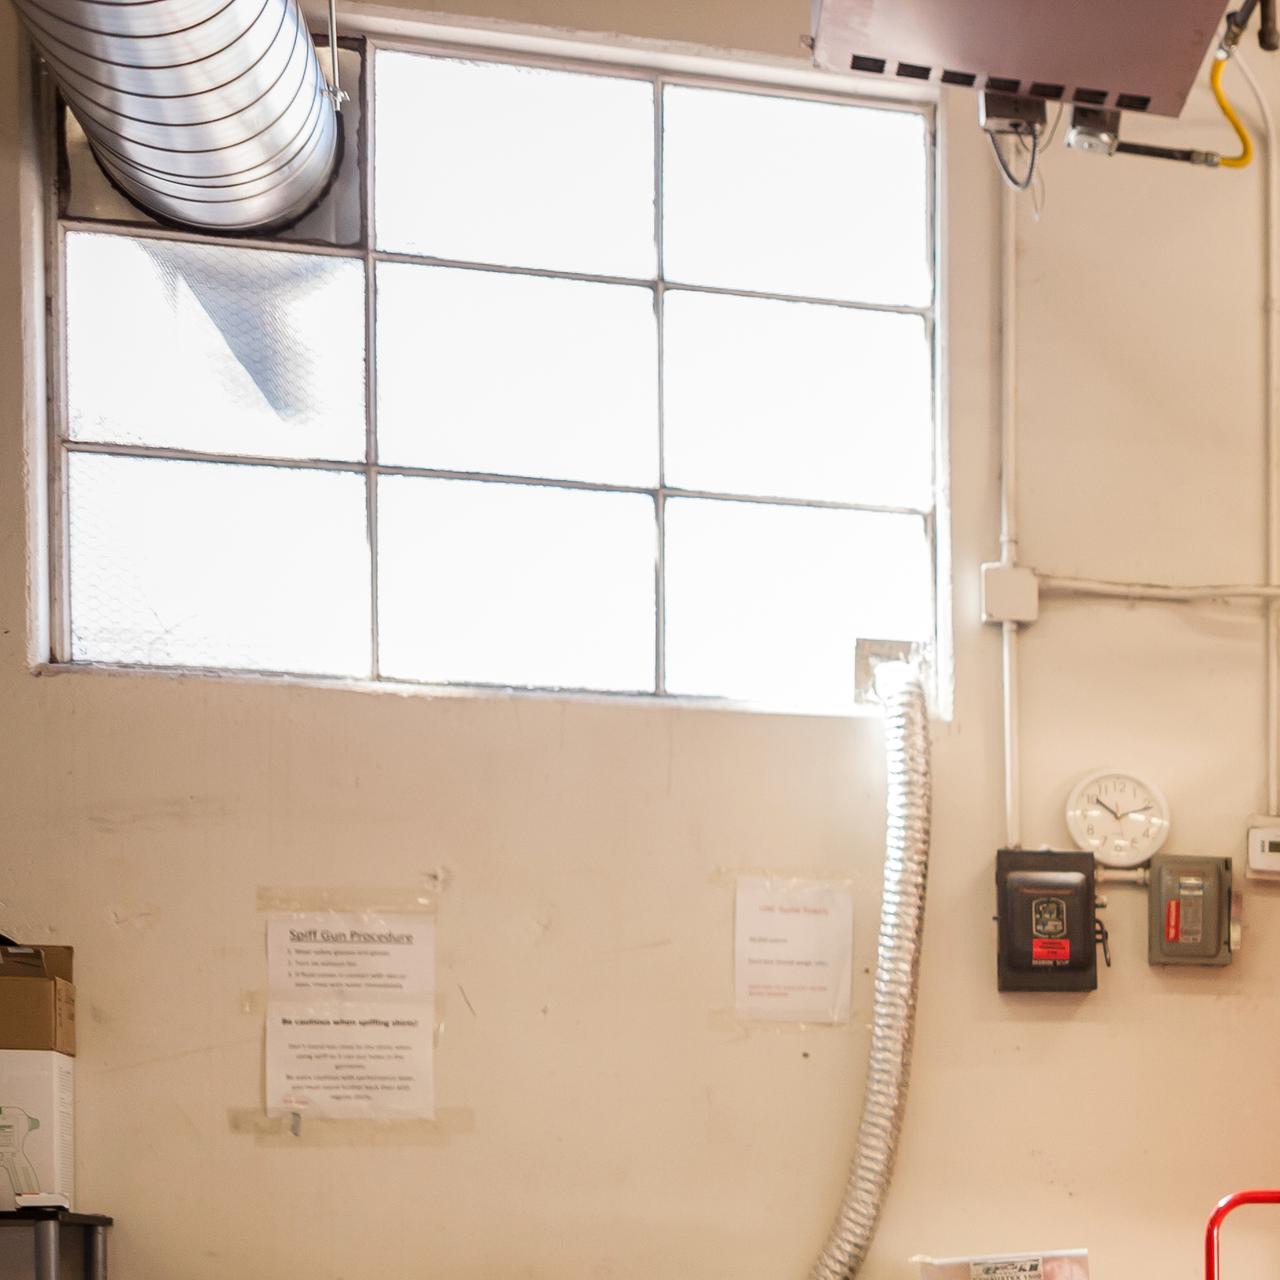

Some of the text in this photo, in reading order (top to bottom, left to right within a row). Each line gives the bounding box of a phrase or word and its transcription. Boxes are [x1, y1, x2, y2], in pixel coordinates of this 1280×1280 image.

[1113, 781, 1127, 793] 12
[320, 930, 347, 943] Gun
[349, 930, 415, 945] Procedure
